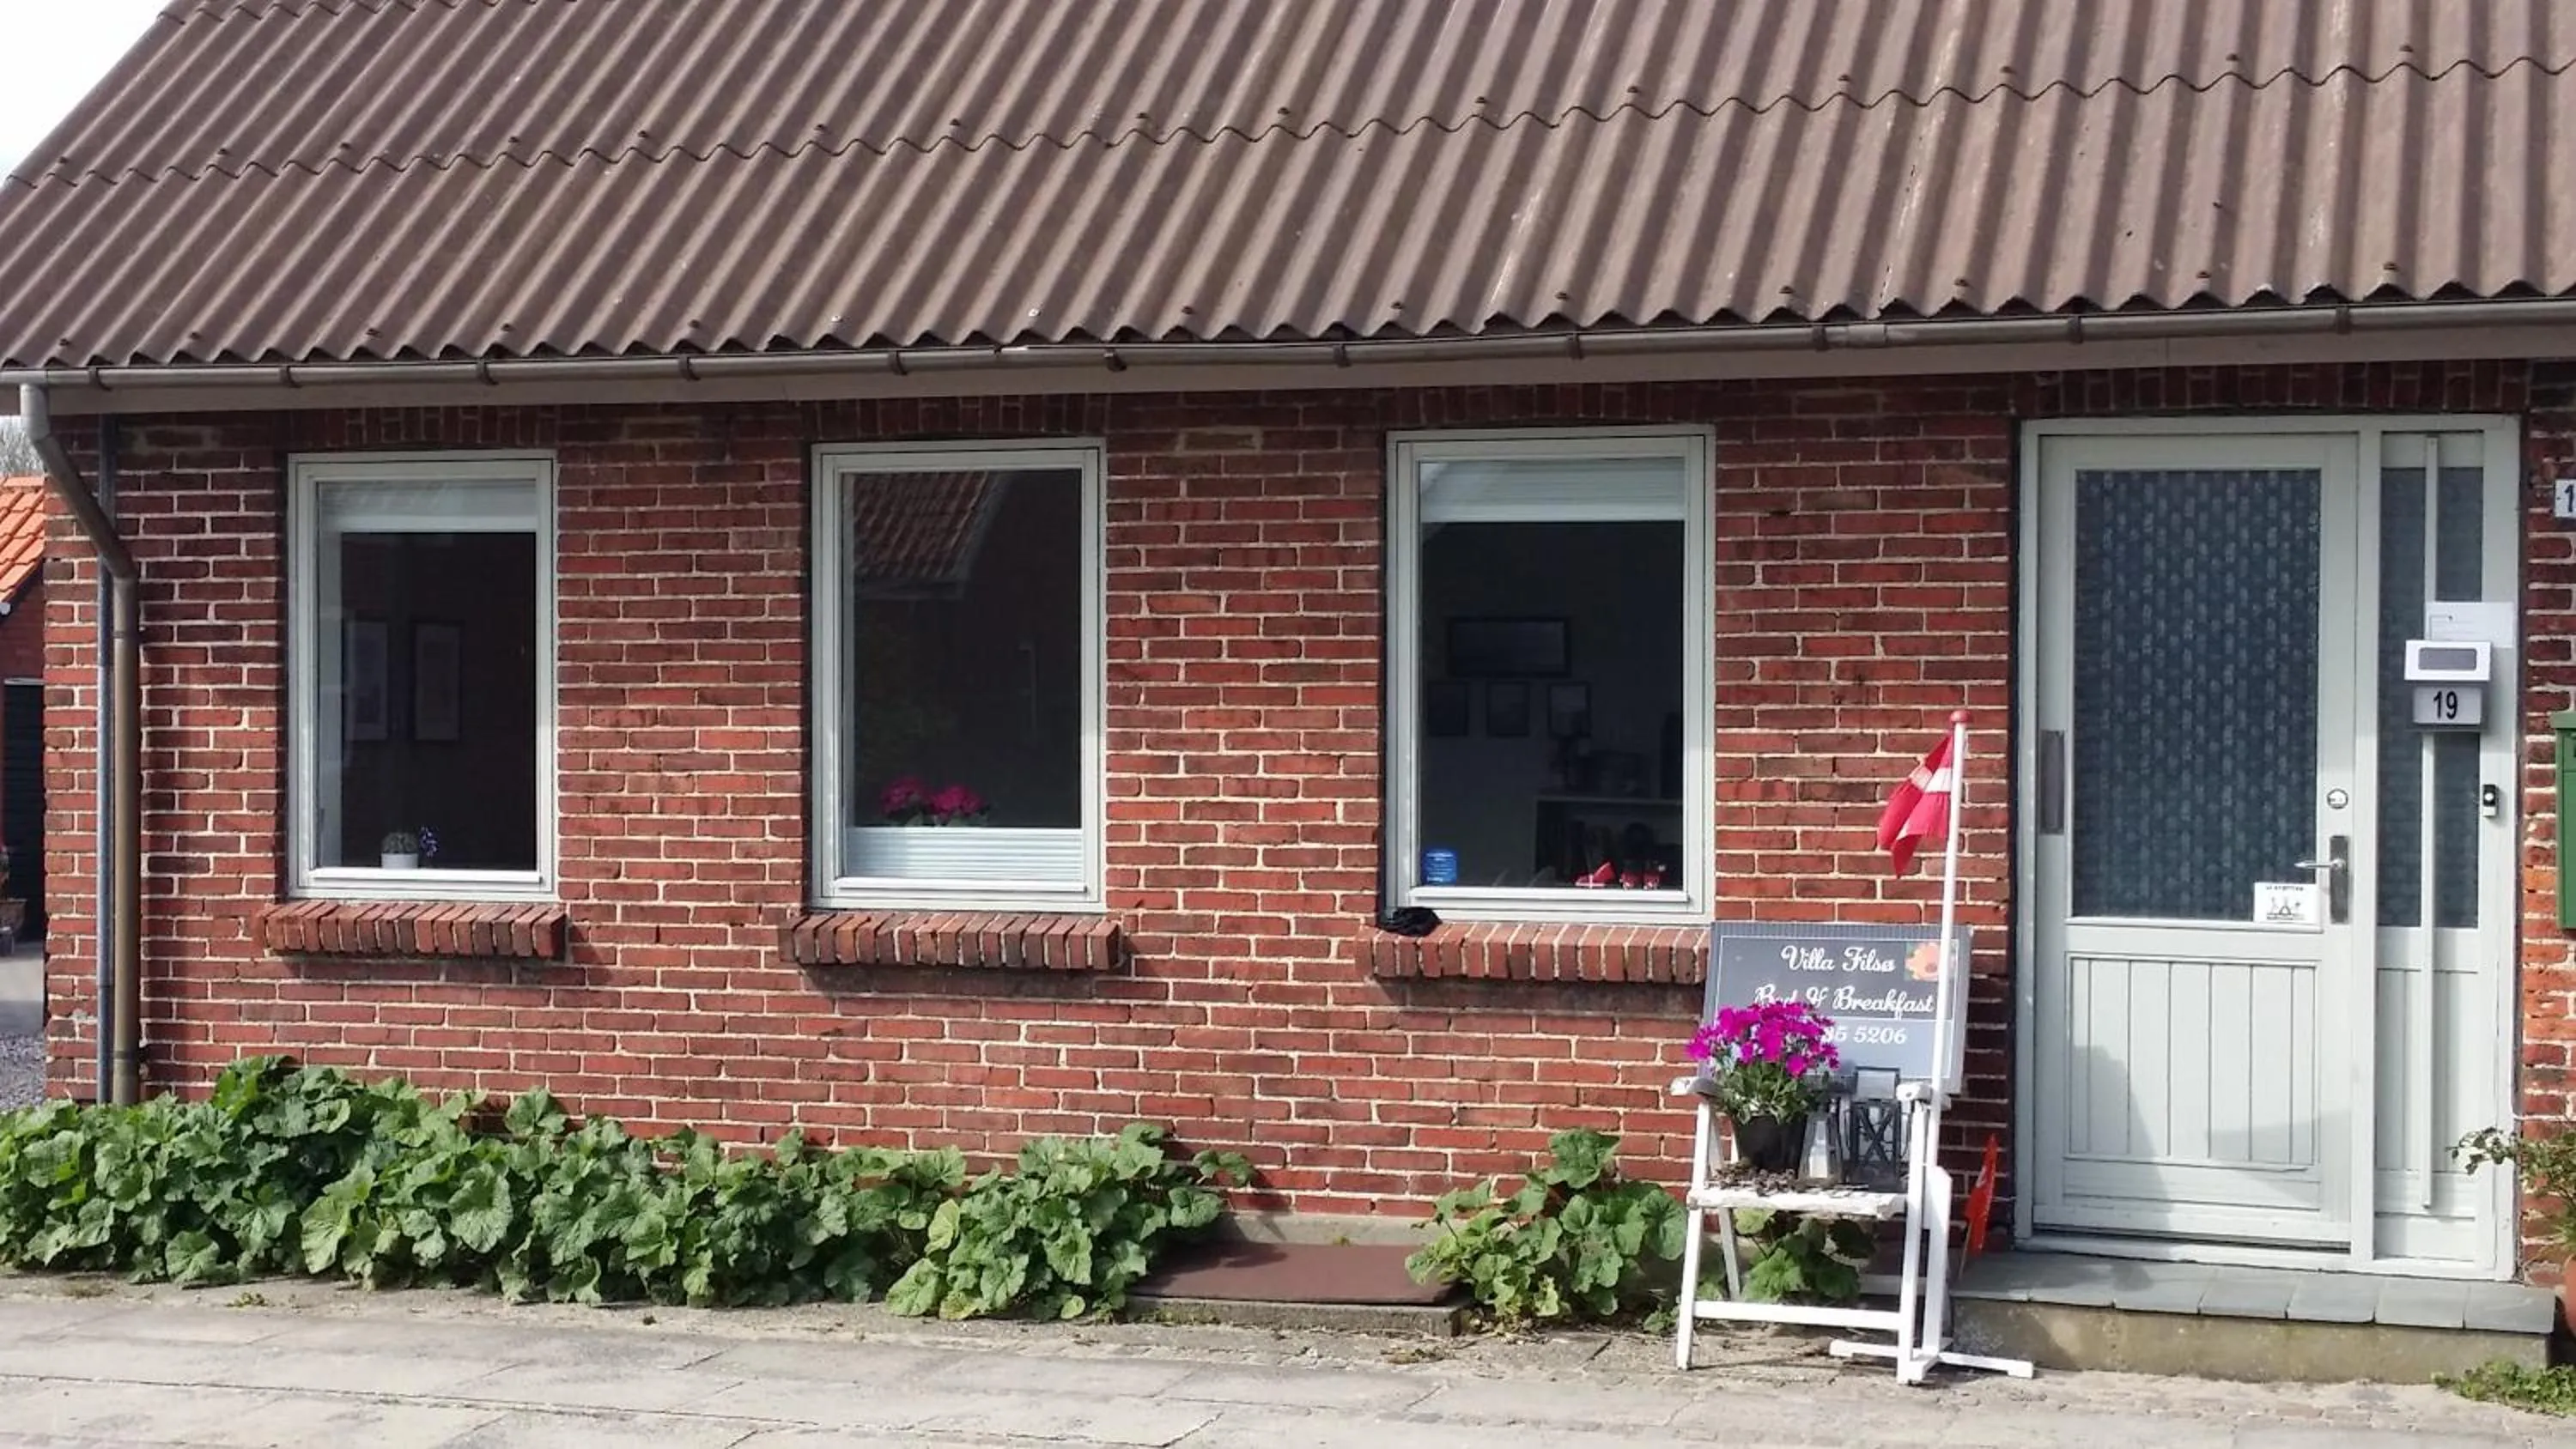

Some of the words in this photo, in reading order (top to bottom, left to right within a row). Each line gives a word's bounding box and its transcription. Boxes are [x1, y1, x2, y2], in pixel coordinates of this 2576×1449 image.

[2433, 690, 2458, 719] 19
[1780, 945, 1836, 971] Villa
[1832, 985, 1935, 1021] Breakfast
[1854, 1026, 1907, 1045] 5206
